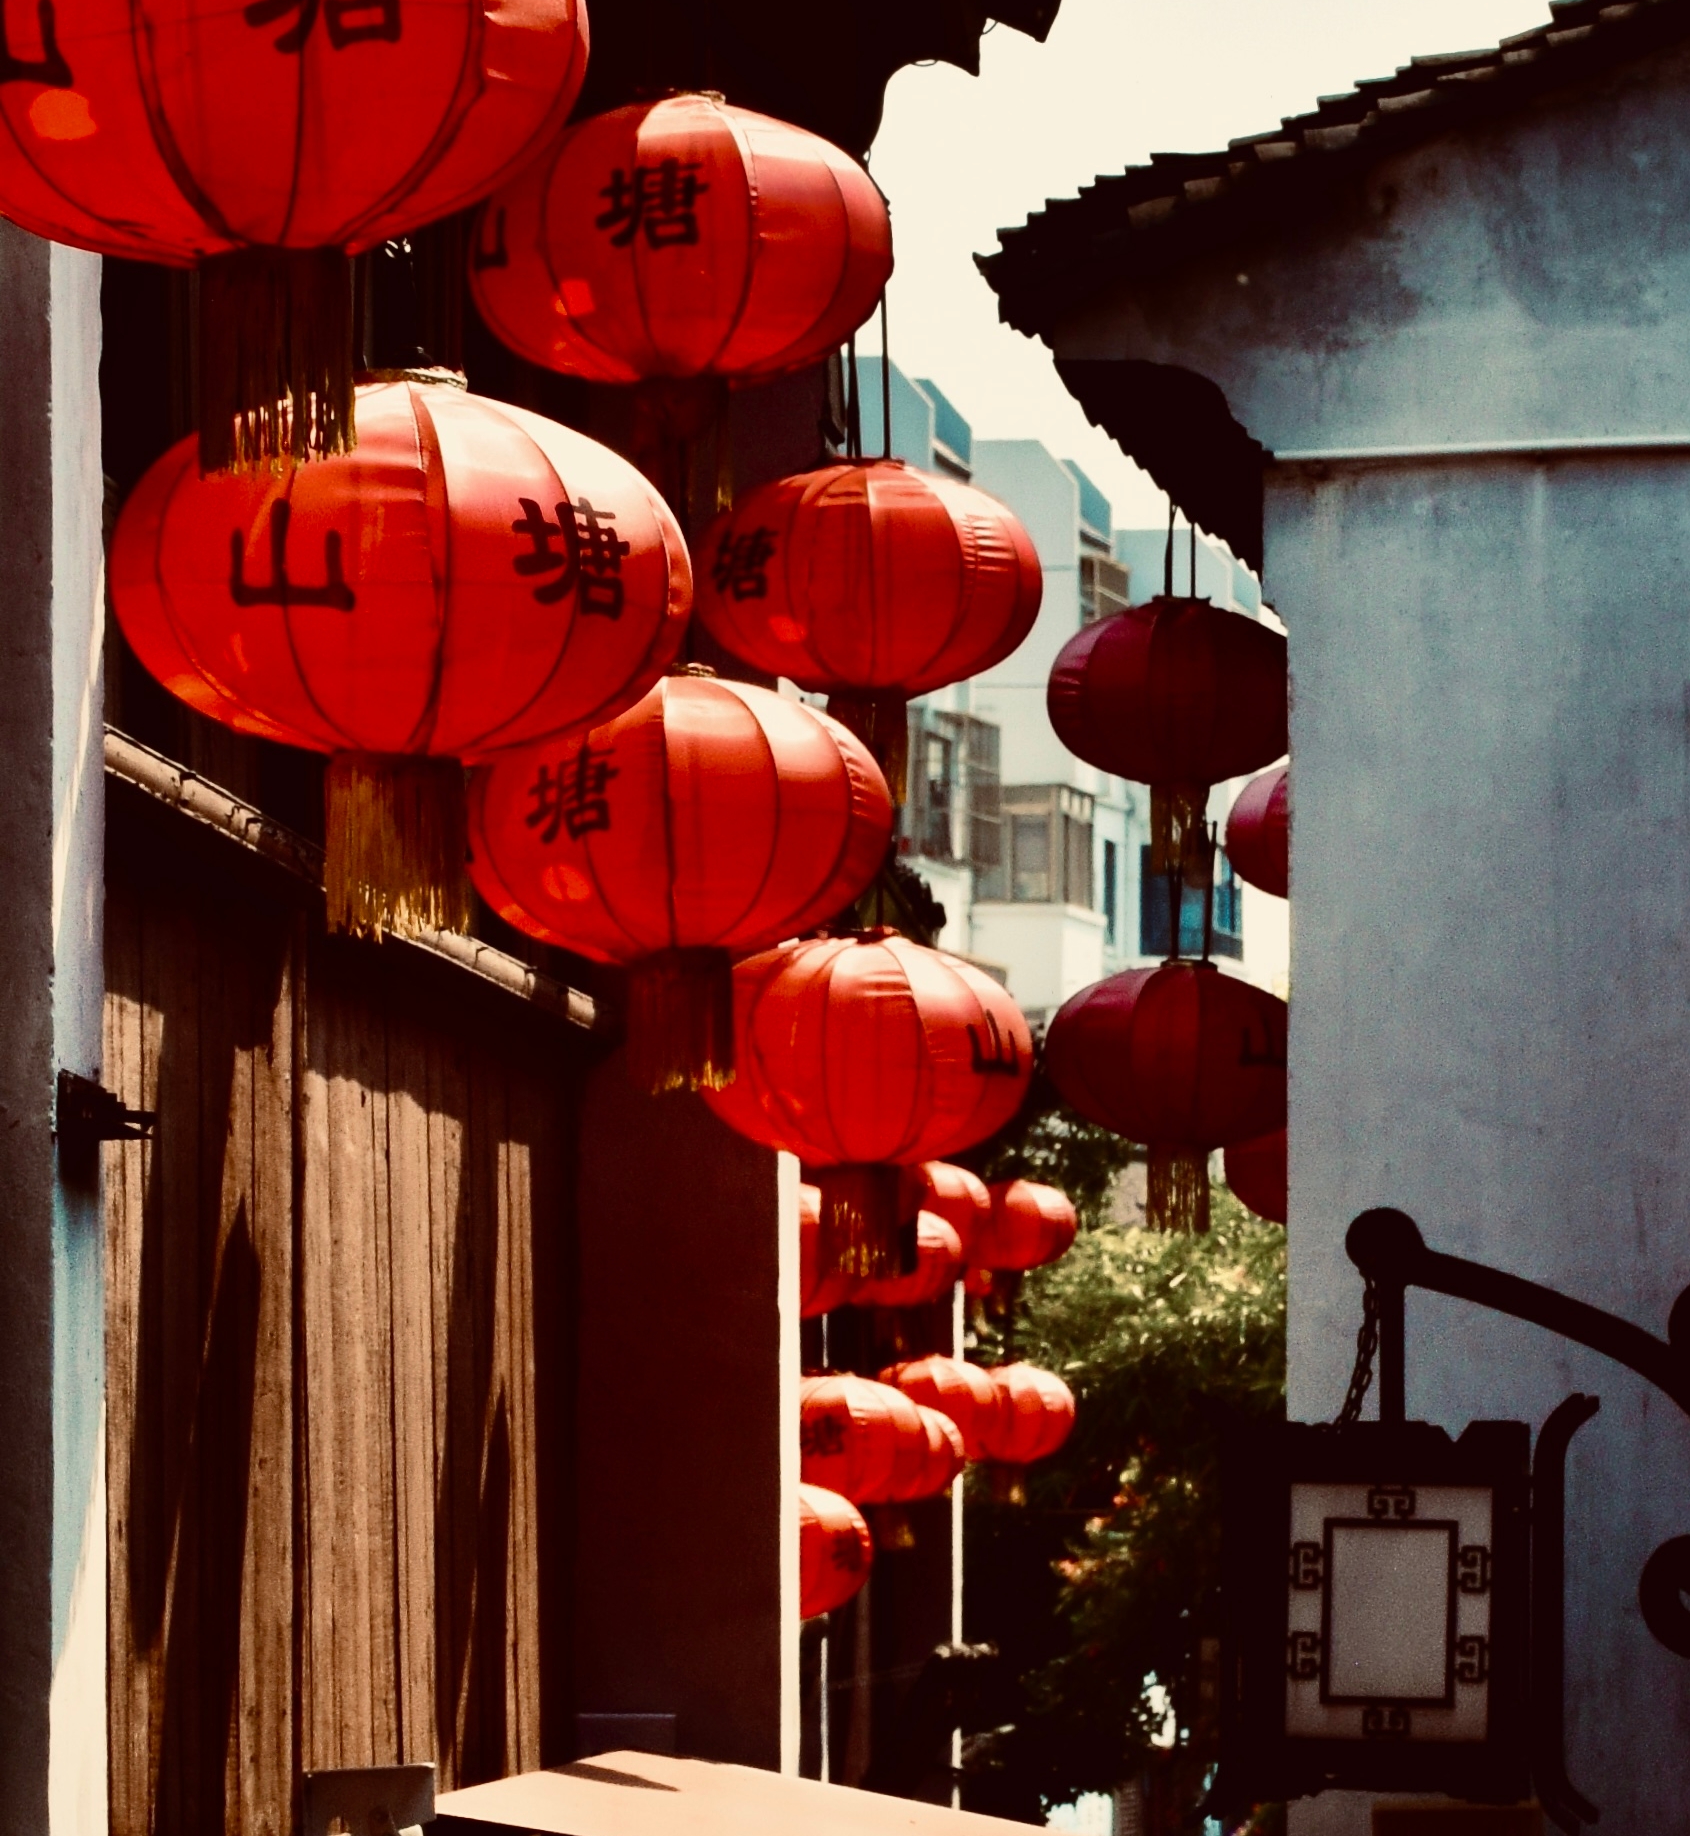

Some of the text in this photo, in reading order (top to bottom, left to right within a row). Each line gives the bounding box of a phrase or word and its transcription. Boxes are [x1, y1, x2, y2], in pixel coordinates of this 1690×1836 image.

[594, 157, 711, 251] 塘
[230, 496, 630, 619] 山 塘
[712, 527, 779, 600] 塘
[525, 743, 621, 844] 塘
[966, 1009, 1019, 1076] 山
